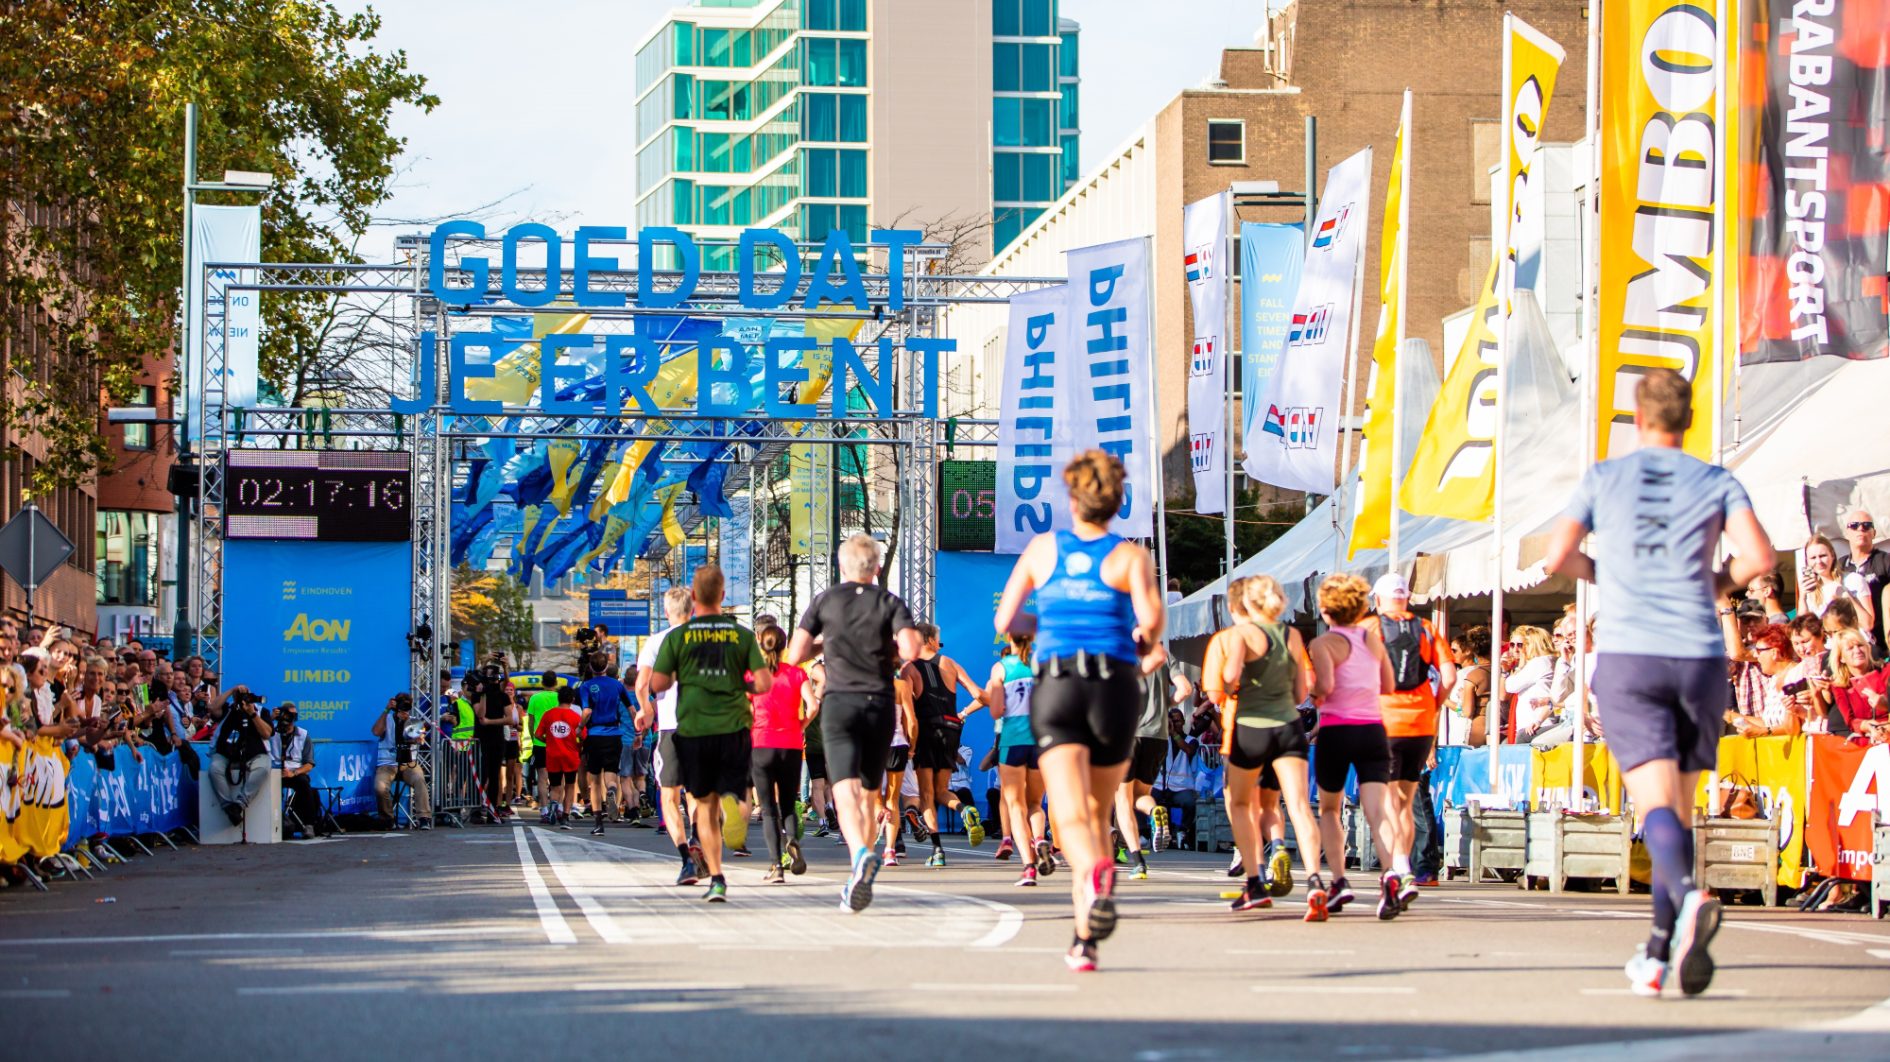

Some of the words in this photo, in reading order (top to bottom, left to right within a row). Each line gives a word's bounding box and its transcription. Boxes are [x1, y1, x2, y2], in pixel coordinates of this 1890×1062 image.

[429, 219, 701, 308] GOED
[738, 228, 923, 311] DAT
[1259, 298, 1285, 309] FALL
[390, 331, 504, 415] JE
[541, 333, 662, 417] ER
[697, 336, 957, 419] BENT
[239, 478, 406, 511] 02:17:16
[1633, 467, 1676, 559] NIKE
[301, 586, 352, 596] EINDHOVEN
[283, 668, 352, 684] JUMBO
[298, 700, 351, 711] BRABANT
[298, 710, 335, 721] SPORT
